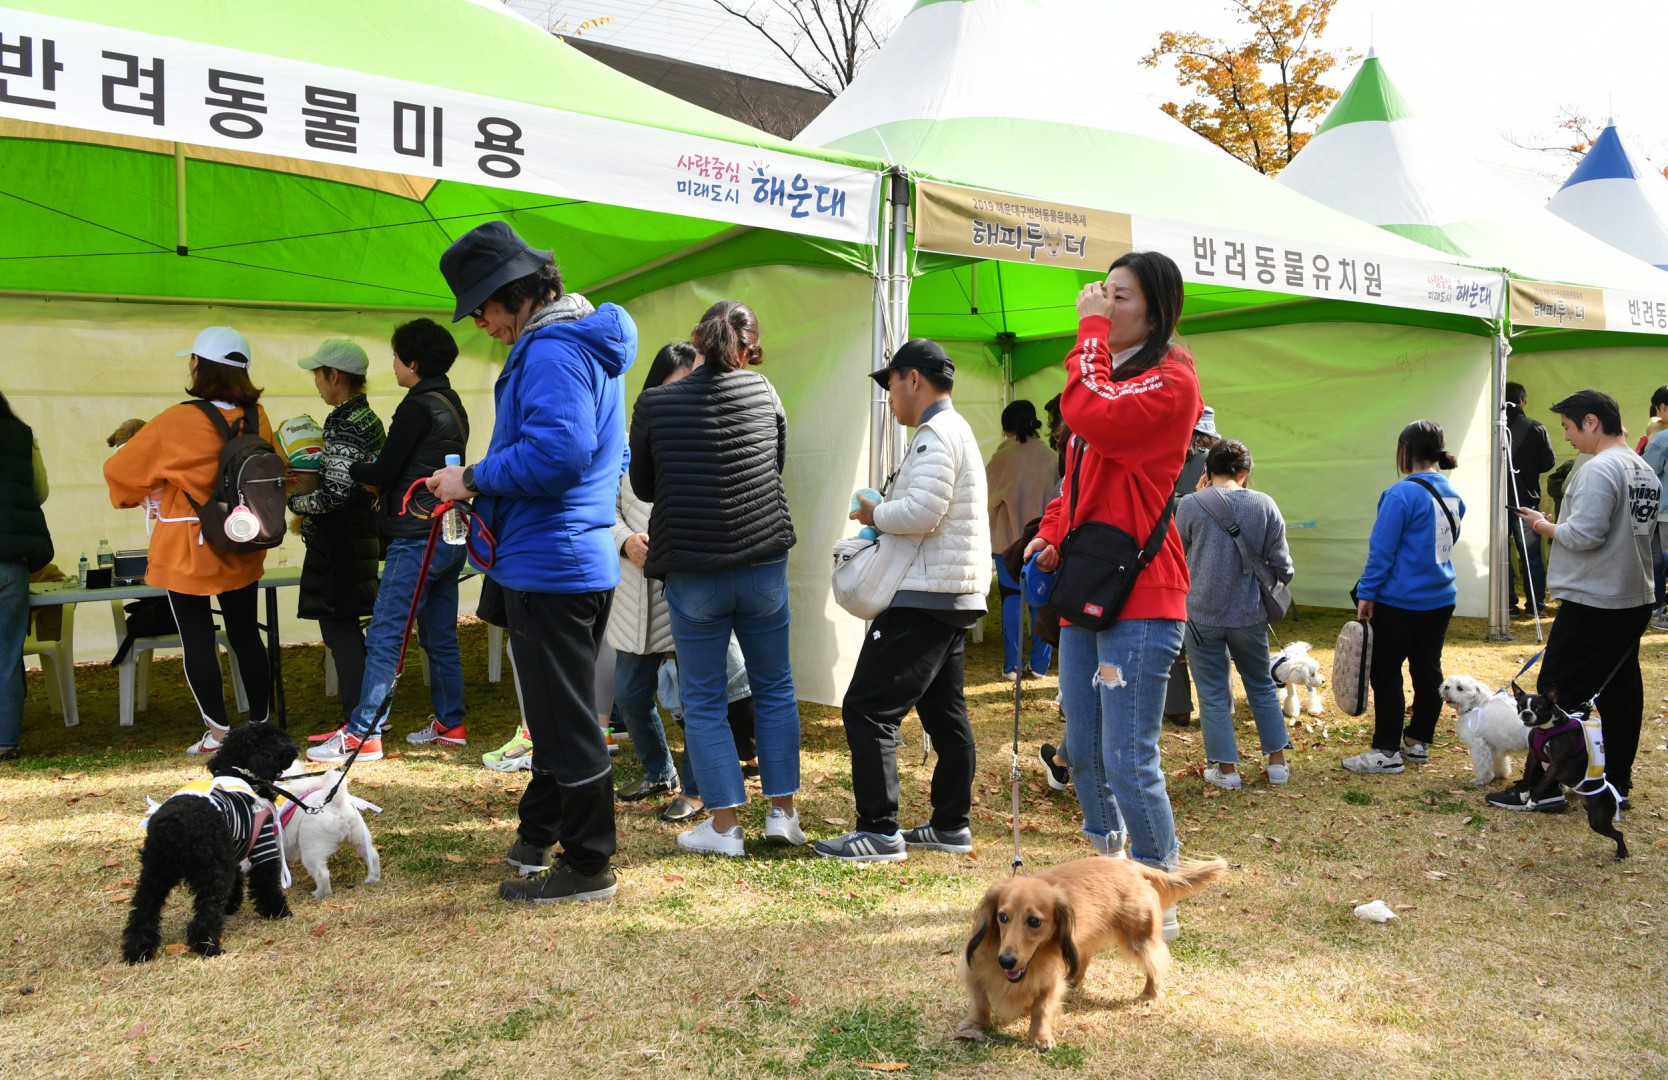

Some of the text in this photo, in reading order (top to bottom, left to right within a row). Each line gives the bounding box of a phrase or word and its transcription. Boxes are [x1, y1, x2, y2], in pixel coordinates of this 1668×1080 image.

[0, 31, 525, 179] 반려동물미용
[676, 154, 741, 184] 사람중심
[676, 179, 740, 205] 미래도시
[750, 167, 847, 218] 해운대
[972, 198, 995, 213] 2019
[1192, 235, 1383, 298] 반려동물유치원
[1455, 280, 1492, 309] 해운대
[1628, 298, 1668, 330] 반려동
